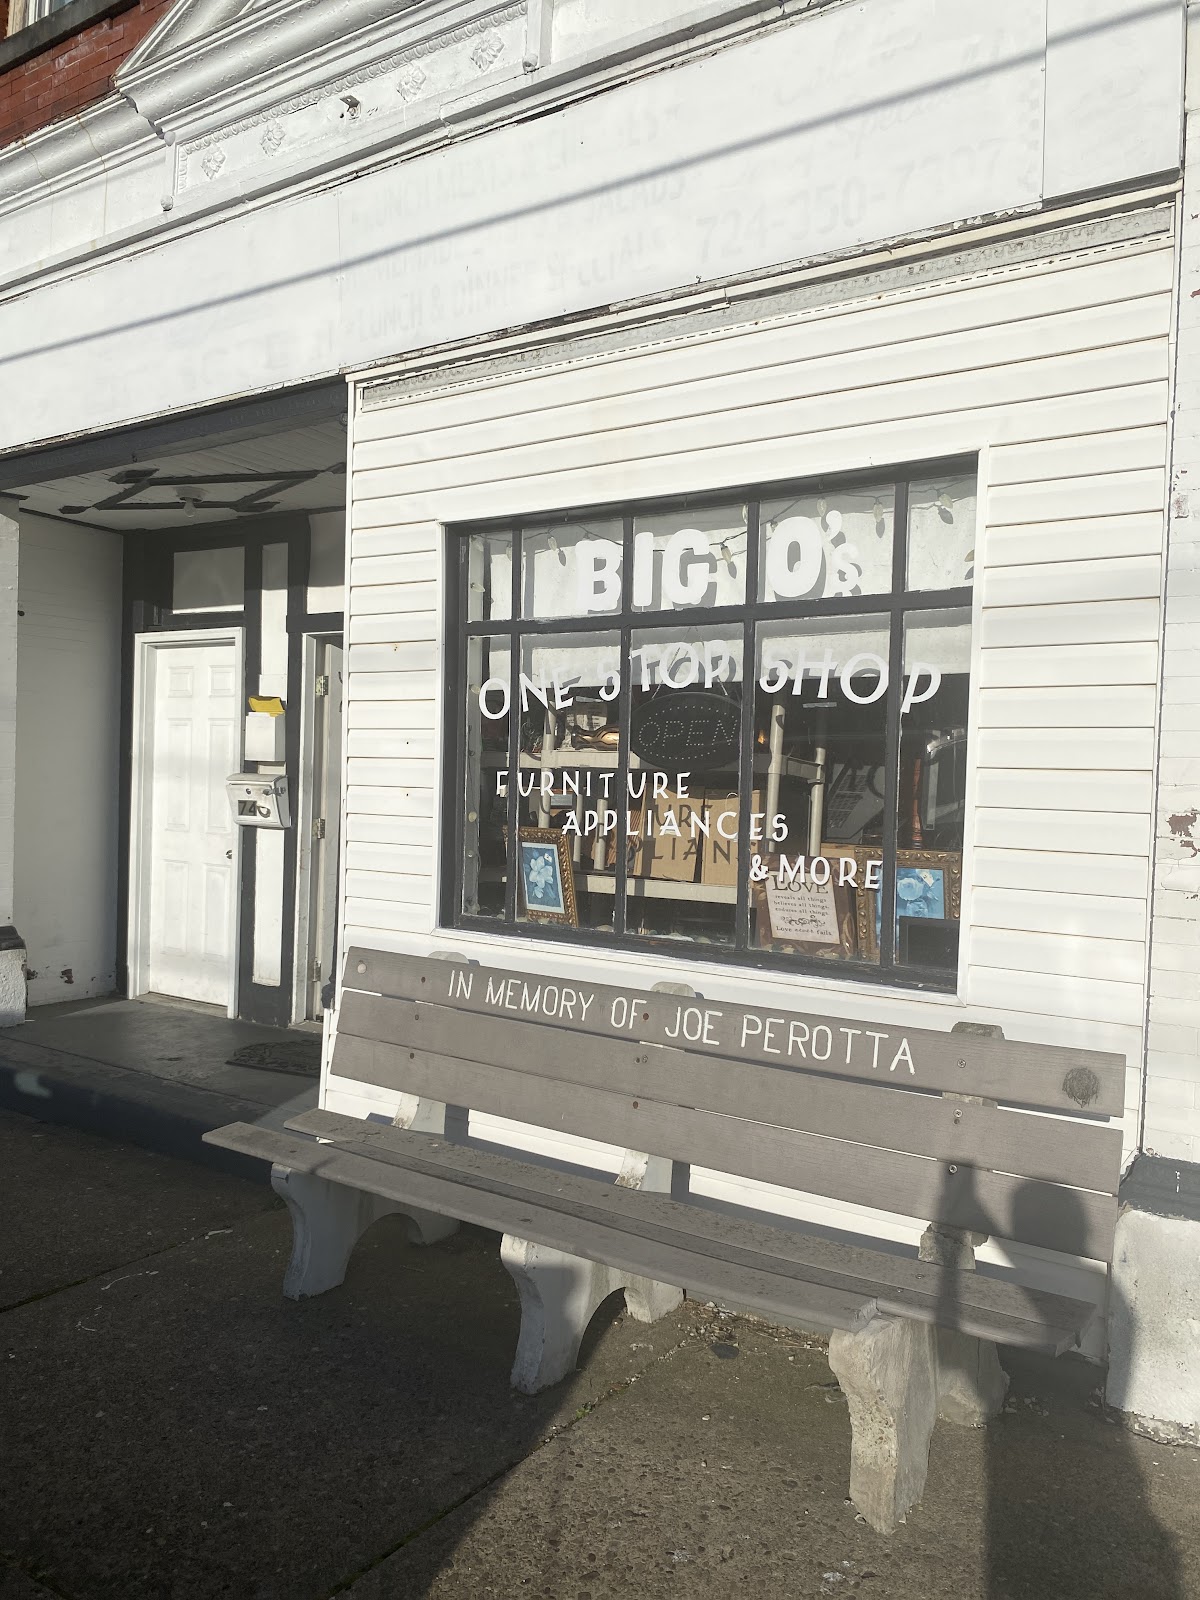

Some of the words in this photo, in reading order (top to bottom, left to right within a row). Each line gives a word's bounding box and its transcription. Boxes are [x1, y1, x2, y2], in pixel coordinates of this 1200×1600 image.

[574, 528, 711, 612] BIG
[768, 510, 860, 598] O's
[478, 671, 574, 719] ONE
[596, 640, 730, 702] STOP
[759, 648, 942, 713] SHOP
[638, 720, 738, 747] OPEN
[496, 771, 692, 801] FURNITURE
[561, 810, 789, 842] APPLIANCES
[749, 854, 768, 883] &
[779, 855, 882, 890] MORE
[447, 969, 476, 999] IN
[486, 977, 595, 1024] MEMORY
[610, 997, 647, 1030] OF
[664, 1007, 721, 1046] JOE
[740, 1014, 916, 1075] PEROTTA
